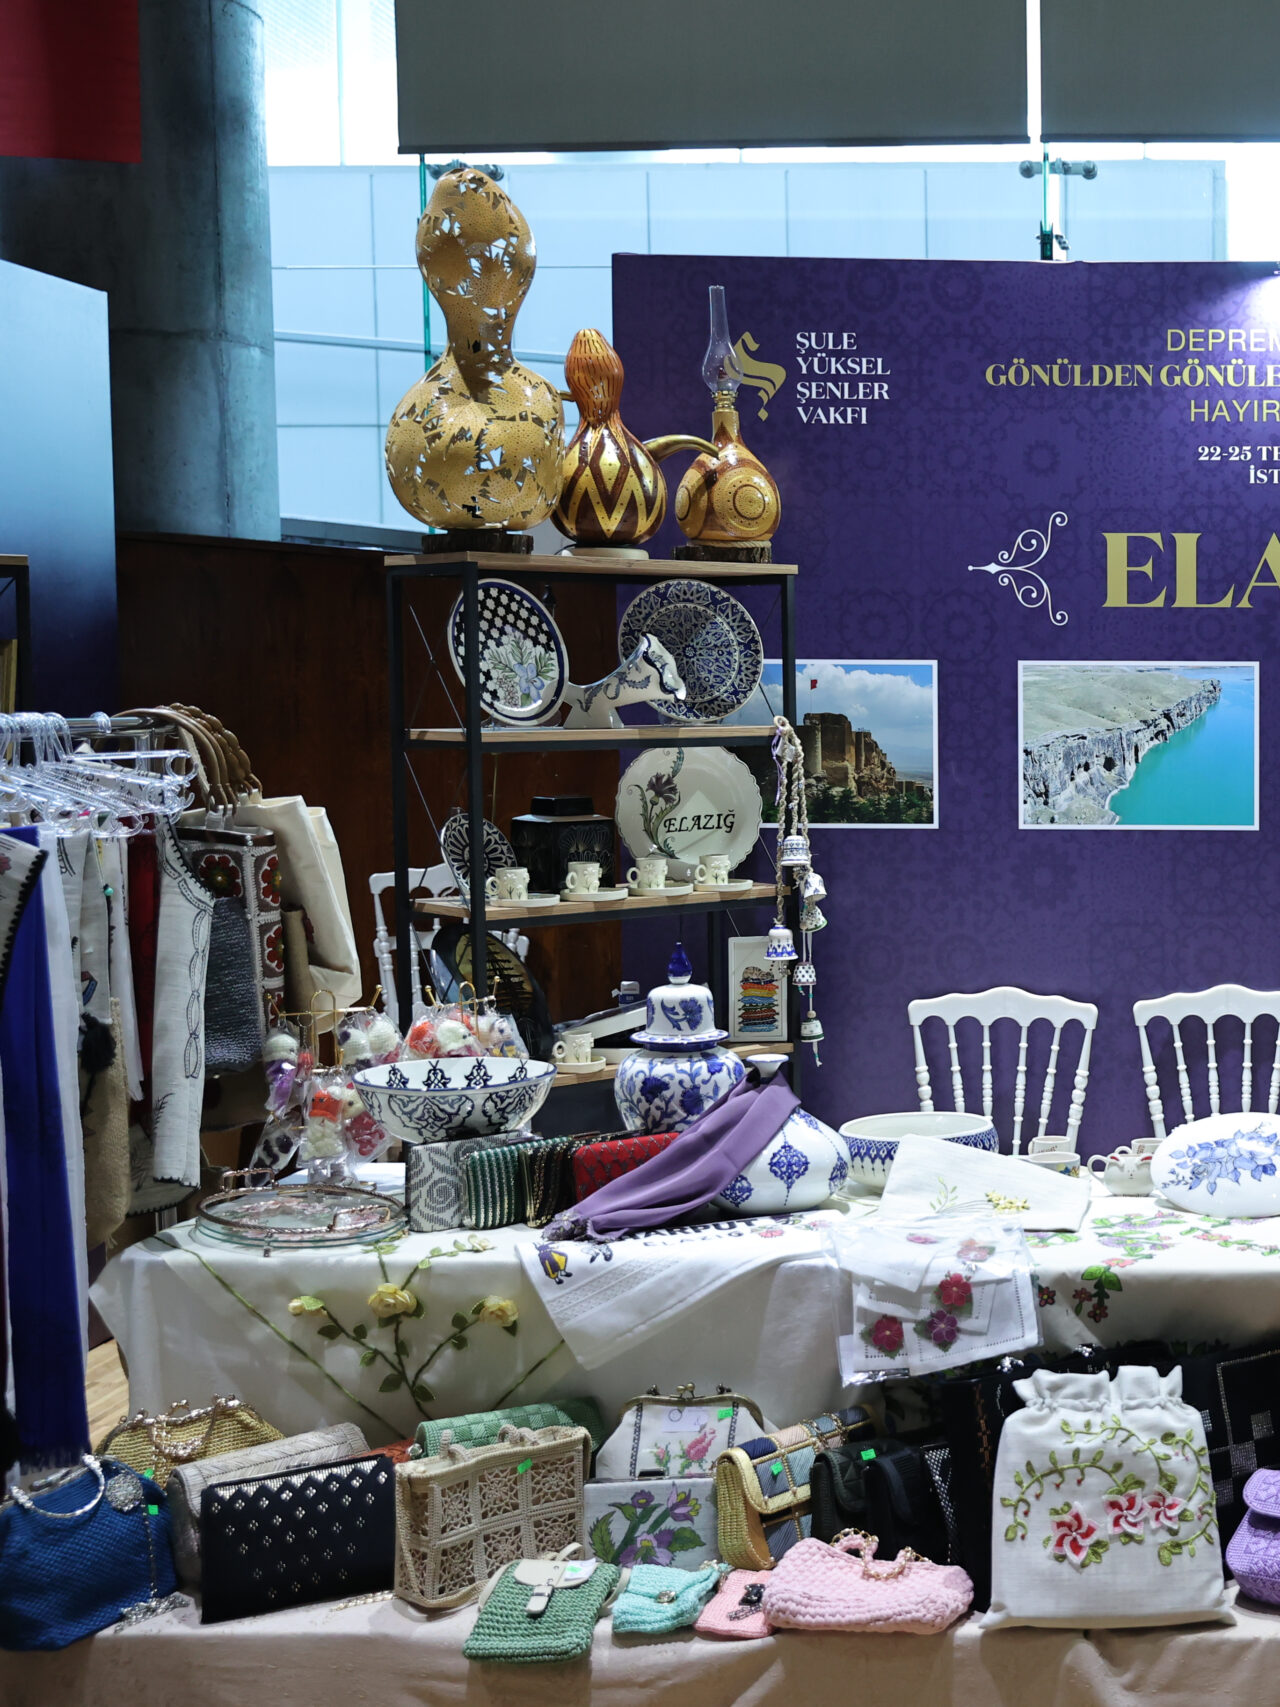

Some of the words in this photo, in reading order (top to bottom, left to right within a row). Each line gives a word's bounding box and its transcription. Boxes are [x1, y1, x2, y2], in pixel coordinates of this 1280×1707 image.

[796, 331, 857, 355] ŞULE
[796, 352, 891, 375] YÜKSEL
[985, 358, 1153, 387] GÖNÜLDEN
[796, 381, 890, 404] ŞENLER
[796, 406, 867, 425] VAKFI
[1190, 399, 1280, 422] HAYIR
[1198, 446, 1252, 461] 22-25
[663, 809, 736, 834] ELAZIĞ
